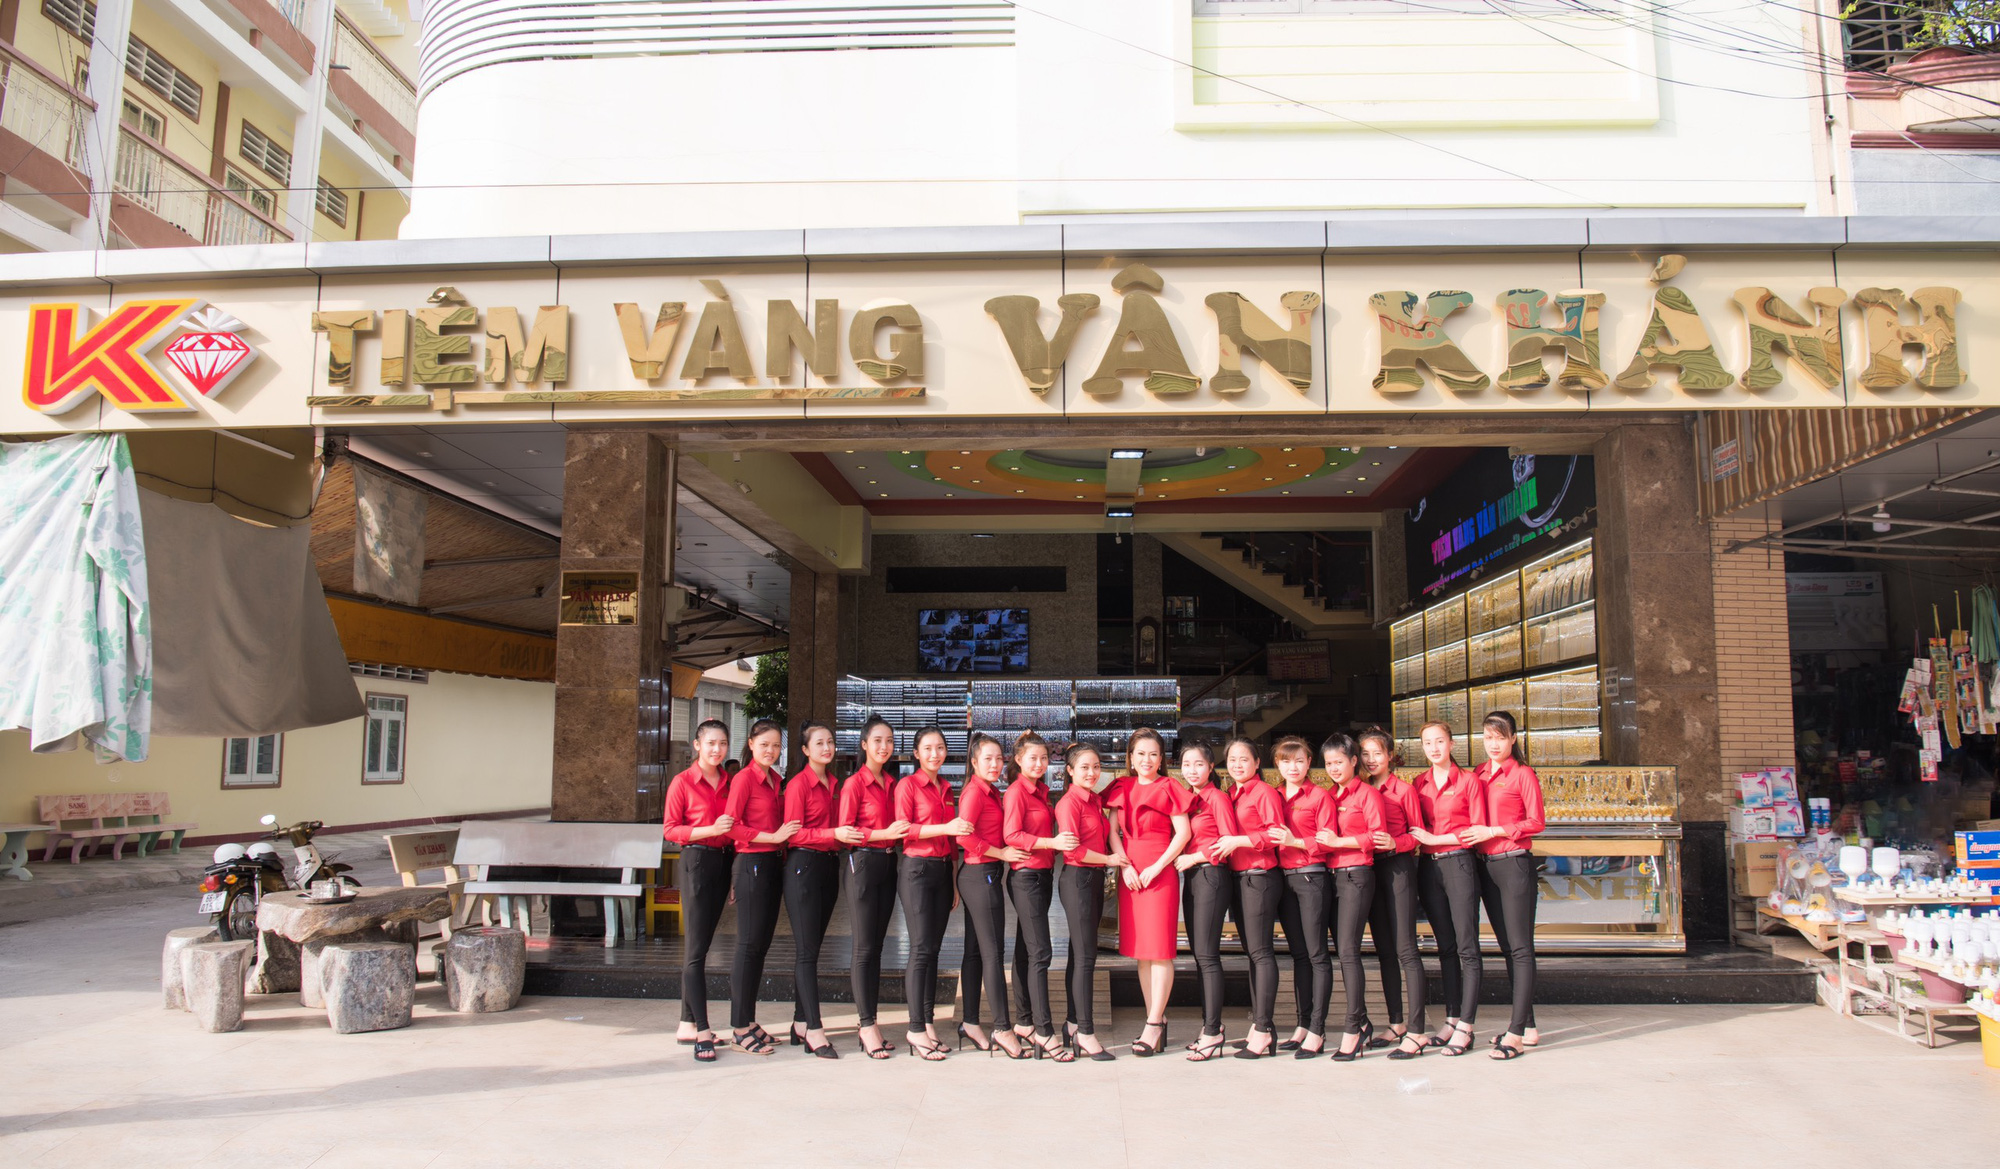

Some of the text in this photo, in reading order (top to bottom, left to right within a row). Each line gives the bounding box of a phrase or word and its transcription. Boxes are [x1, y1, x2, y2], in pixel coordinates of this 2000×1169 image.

[311, 254, 1969, 410] TIỆM VÀNG VÂN KHÁNH
